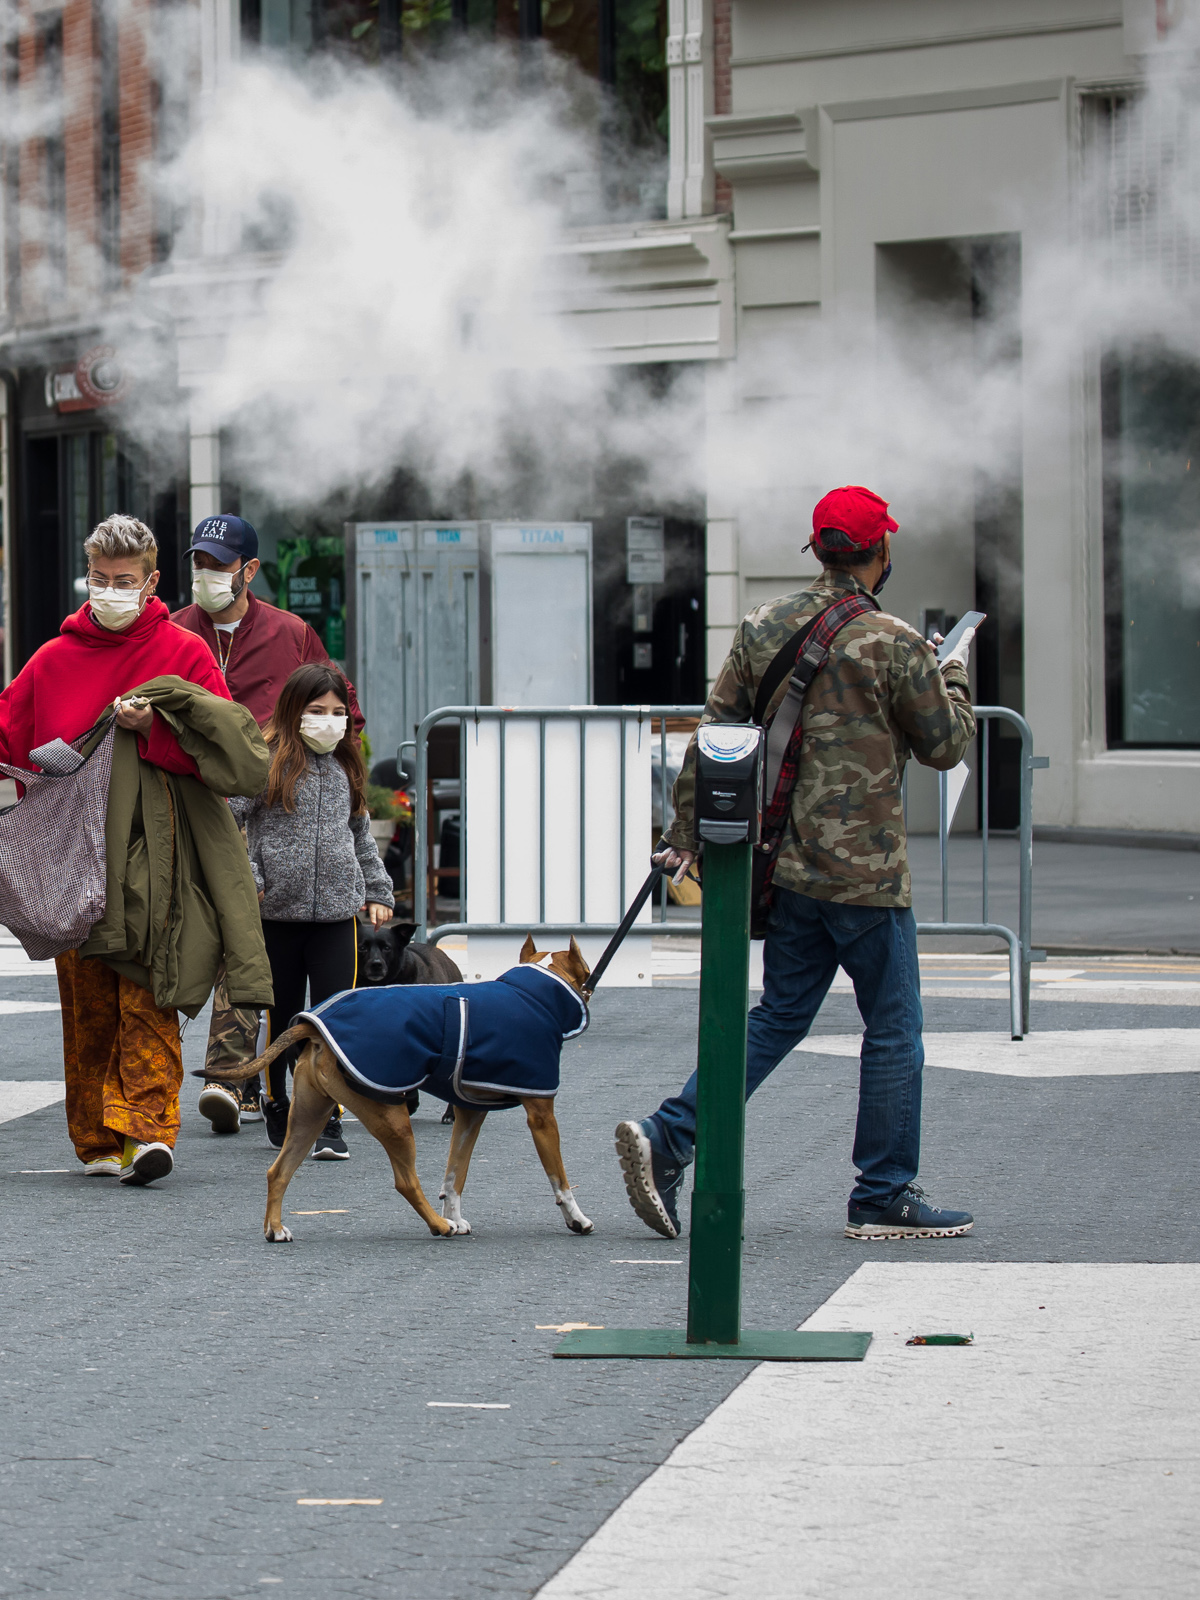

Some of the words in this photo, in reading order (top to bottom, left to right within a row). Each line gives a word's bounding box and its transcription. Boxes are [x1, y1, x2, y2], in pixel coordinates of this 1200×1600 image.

[206, 520, 228, 528] THE
[202, 526, 227, 536] FAT
[374, 530, 399, 543] TITAN
[436, 530, 461, 543] TITAN
[519, 529, 565, 543] TITAN
